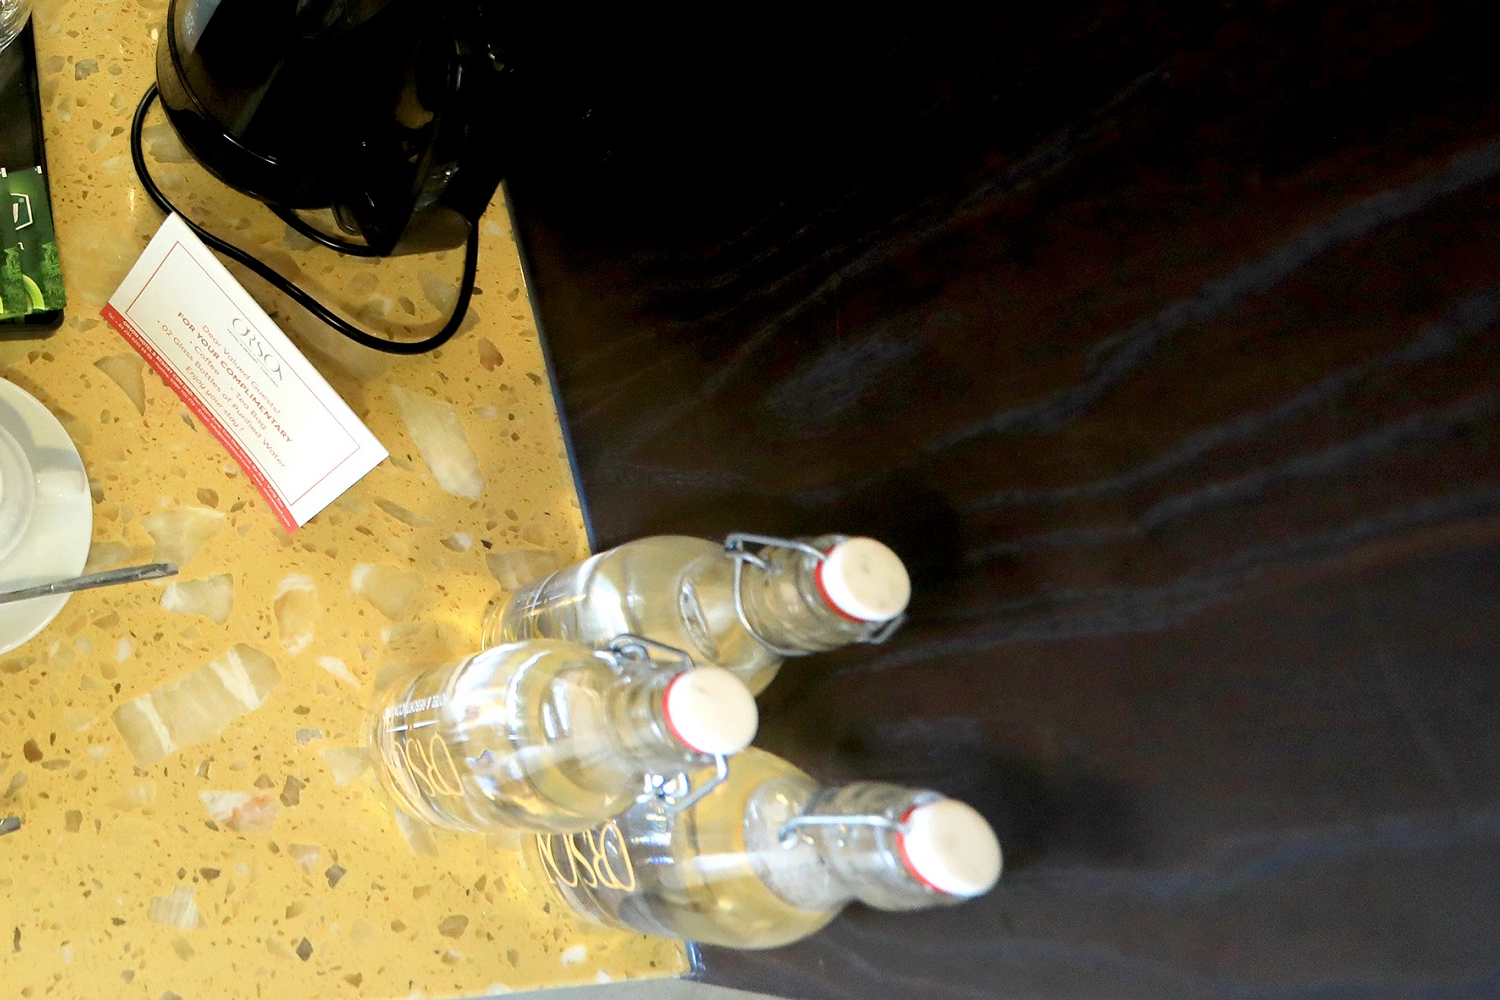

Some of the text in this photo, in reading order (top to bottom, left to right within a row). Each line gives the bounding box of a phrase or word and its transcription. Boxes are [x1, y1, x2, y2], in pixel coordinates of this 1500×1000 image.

[123, 321, 139, 338] ORSON
[138, 337, 152, 353] HOTEL
[156, 355, 173, 374] RESORT
[172, 373, 183, 385] CON
[162, 325, 285, 467] 02 Glass Bottles of Purified Water
[178, 312, 292, 442] FOR YOUR COMPLIMENTARY
[194, 346, 266, 430] Coffee Tea Bag
[202, 325, 280, 414] Dear Valued Guests!
[185, 366, 206, 389] Enjoy
[205, 390, 223, 407] your
[224, 410, 239, 427] stay
